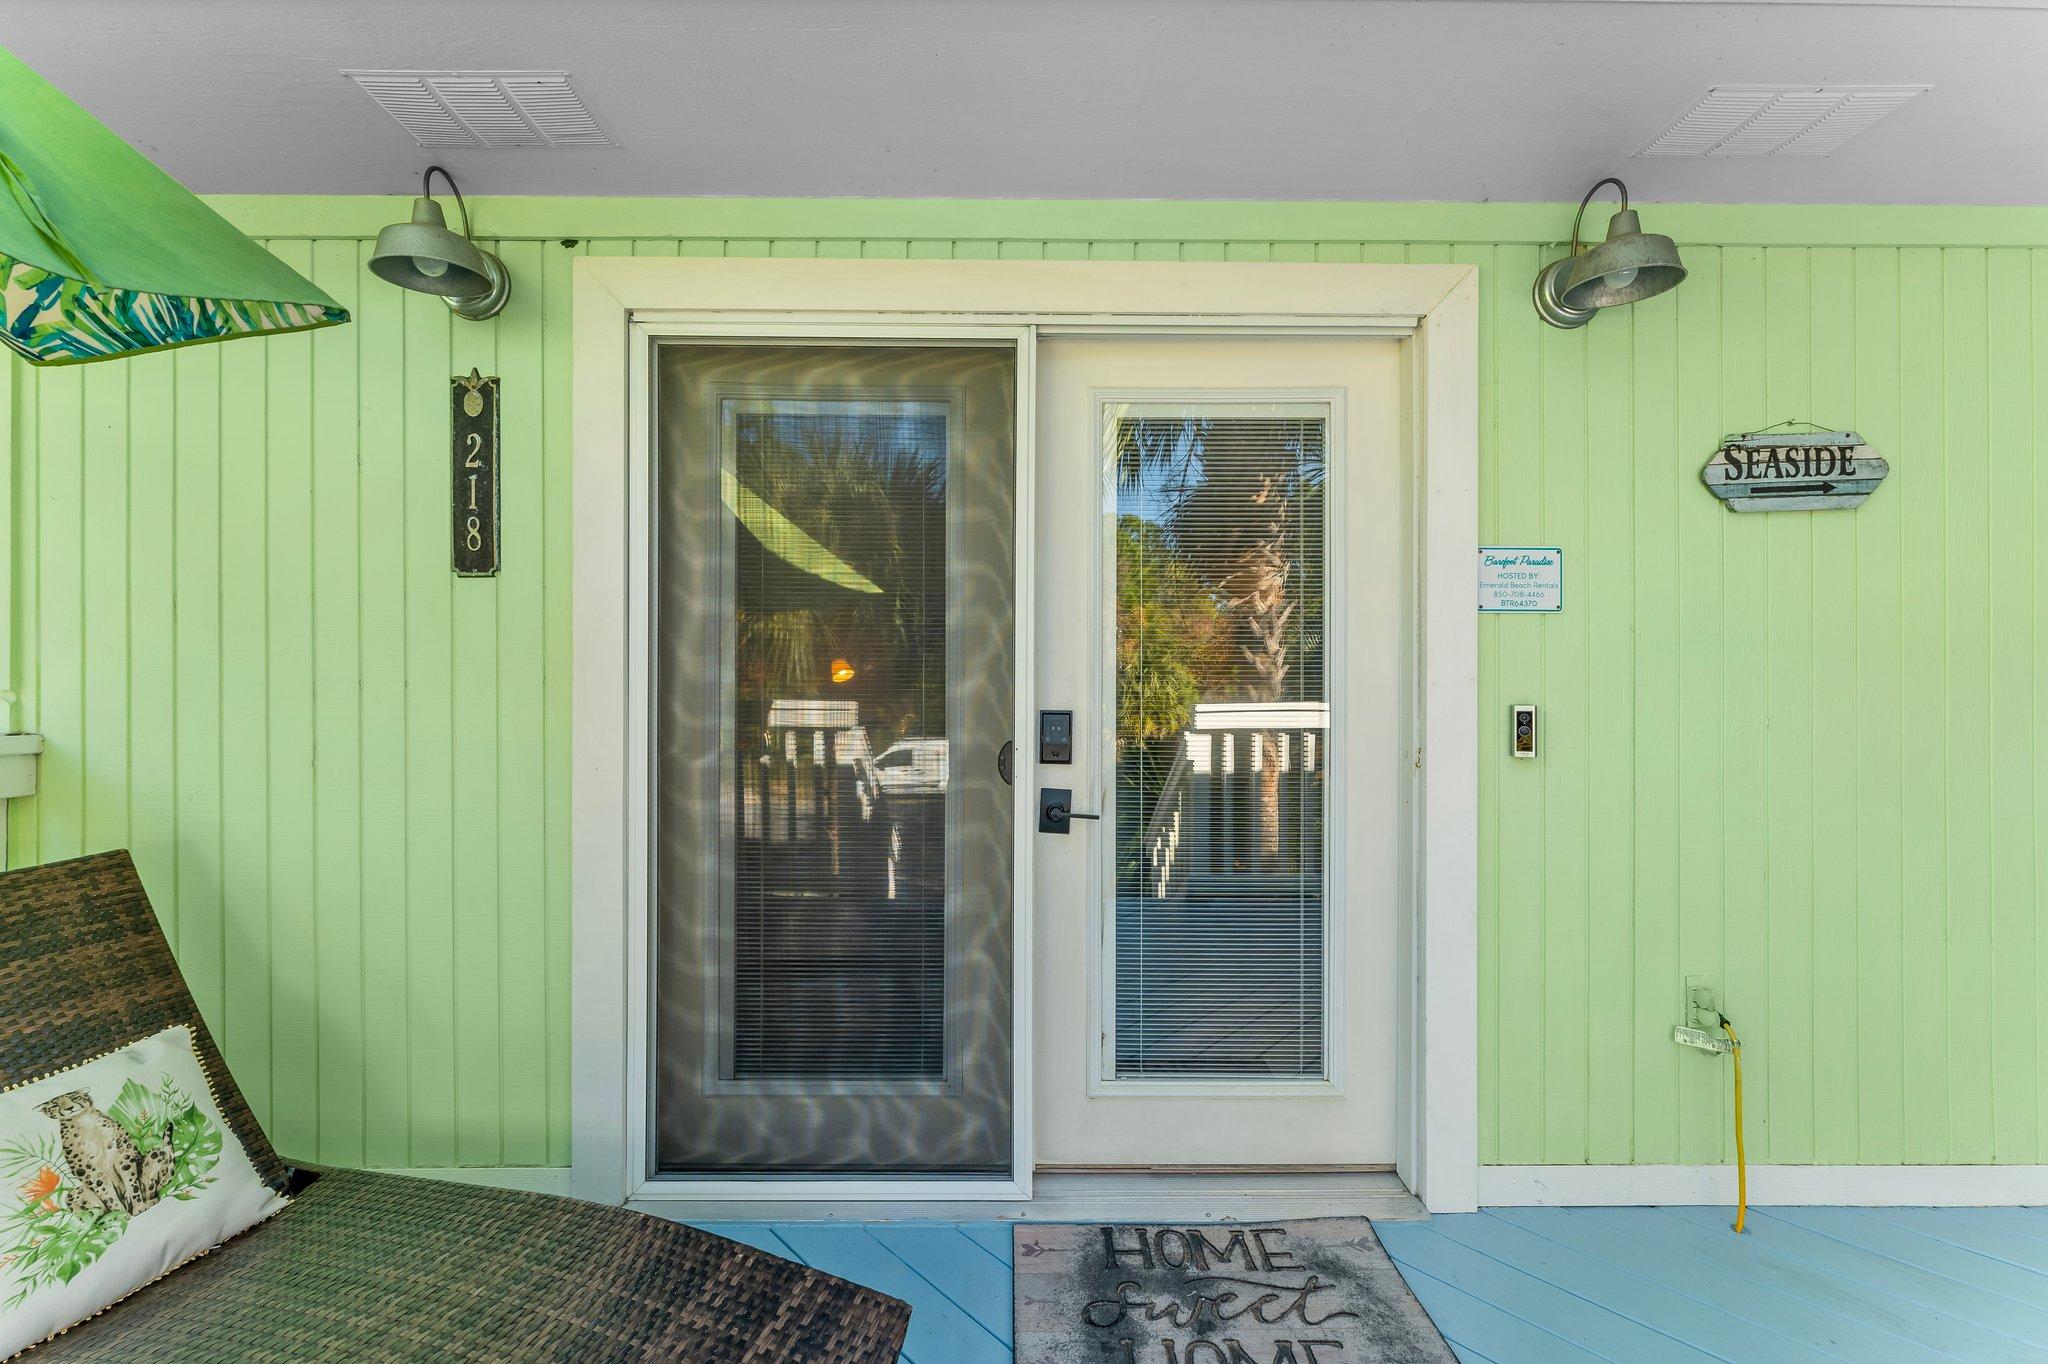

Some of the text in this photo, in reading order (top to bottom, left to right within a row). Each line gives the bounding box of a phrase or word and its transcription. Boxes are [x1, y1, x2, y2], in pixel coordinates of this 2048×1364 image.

[1724, 444, 1857, 481] SEASIDE
[465, 432, 483, 551] 218
[1484, 555, 1554, 569] Barefoot Paradise
[1101, 1227, 1306, 1272] HOME
